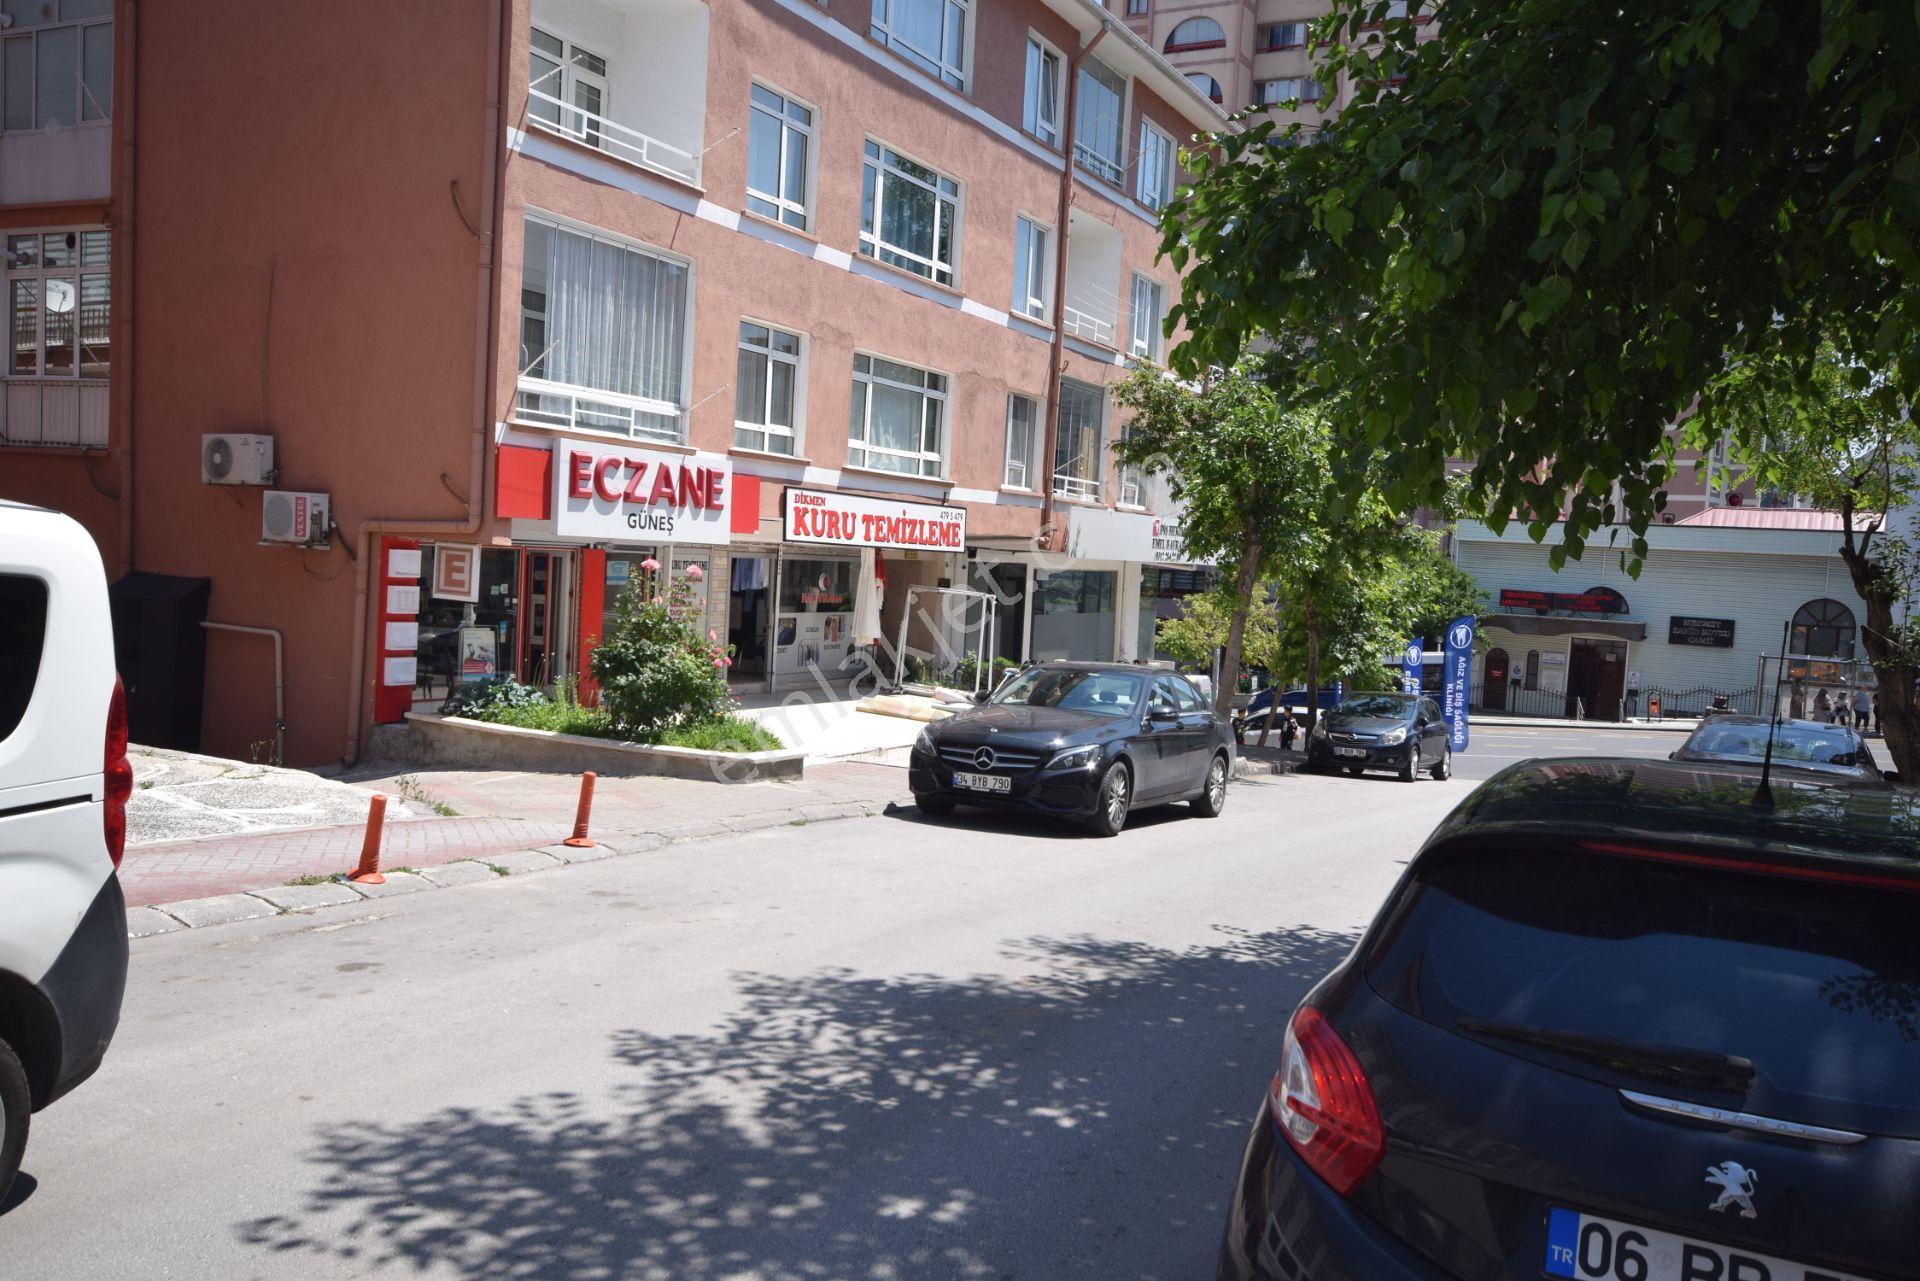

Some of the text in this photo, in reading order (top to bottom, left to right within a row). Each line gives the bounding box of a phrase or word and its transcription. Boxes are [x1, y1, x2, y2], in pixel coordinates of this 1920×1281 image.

[569, 450, 725, 511] ECZANE
[794, 491, 826, 507] DİKMEN
[627, 510, 674, 536] GÜNEŞ
[793, 506, 961, 547] KURU TEMİZLEME
[1445, 683, 1454, 716] KLİNİĞİ
[1453, 656, 1467, 744] AĞIZ VE DİŞ SAĞLIĞI
[958, 774, 968, 785] 34
[992, 777, 1010, 790] 790
[1551, 1245, 1573, 1265] TR
[1578, 1222, 1649, 1281] 06
